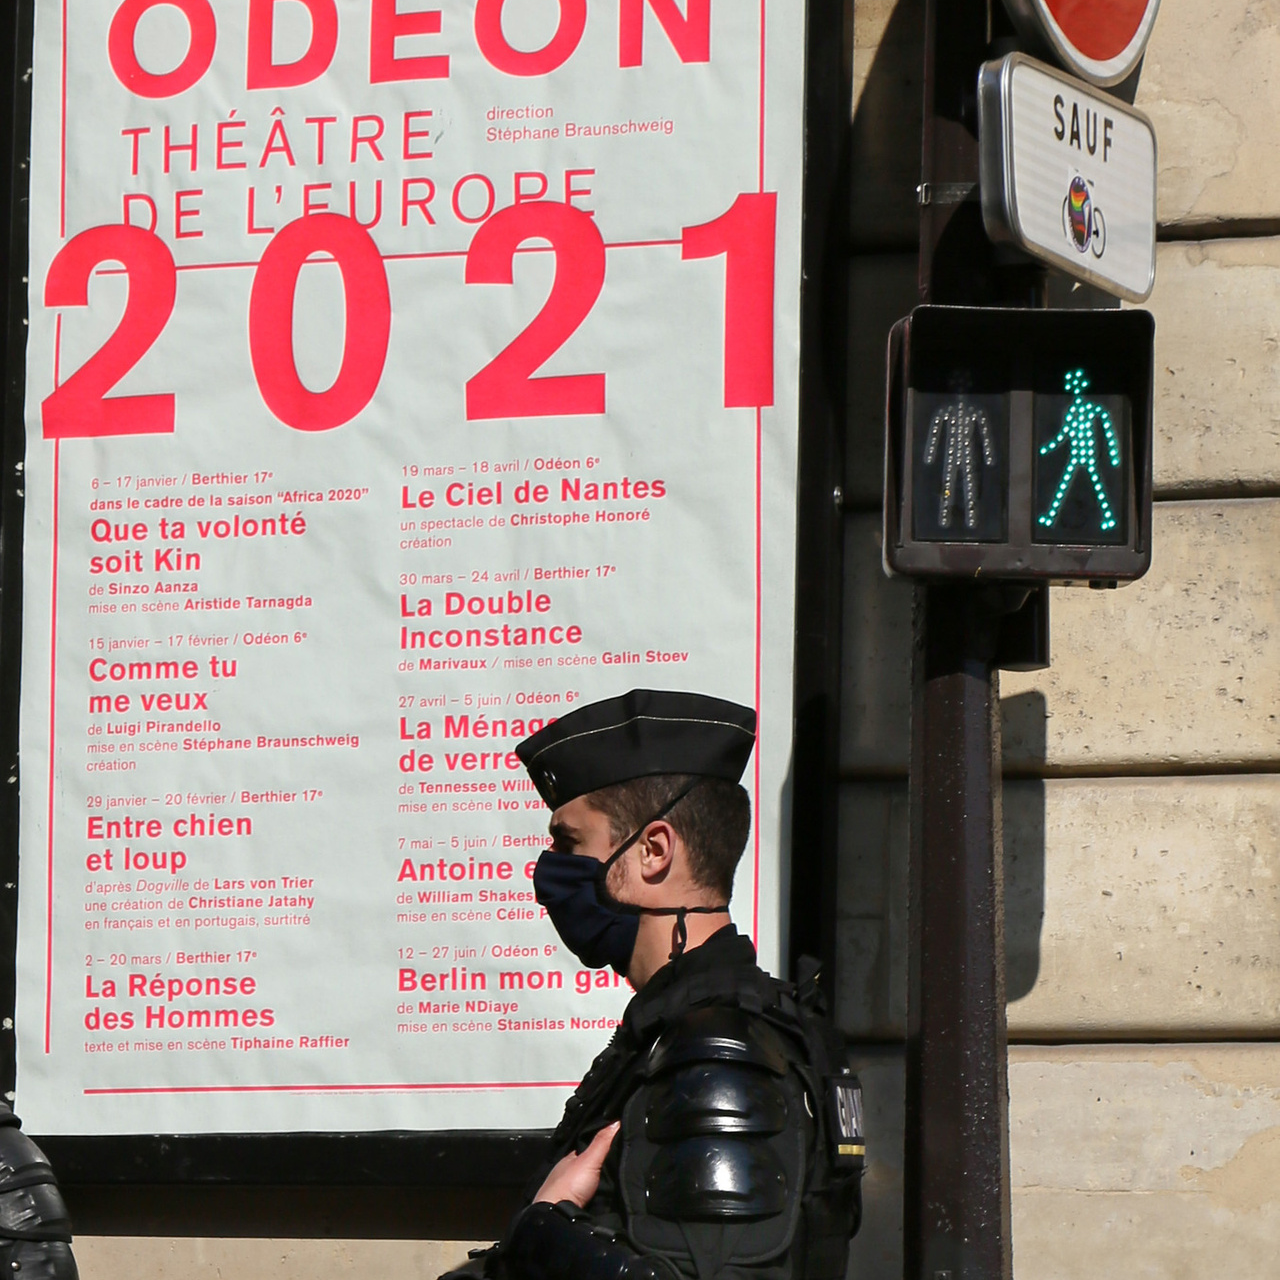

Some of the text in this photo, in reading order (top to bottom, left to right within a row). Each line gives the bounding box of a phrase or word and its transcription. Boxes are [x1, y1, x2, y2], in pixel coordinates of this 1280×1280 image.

[486, 107, 553, 121] direction
[487, 121, 673, 144] Stéphane Braunschweig
[1054, 94, 1113, 162] SAUF
[121, 106, 436, 175] THÉÂTRE
[122, 167, 598, 239] DE L'EUROPE
[40, 191, 778, 440] 2021
[90, 500, 122, 511] dans
[127, 498, 139, 509] le
[144, 497, 183, 509] cadre
[188, 496, 205, 507] de
[210, 495, 222, 507] la
[228, 495, 272, 506] saison
[402, 478, 666, 509] Le Ciel de Nantes
[91, 512, 305, 543] Que ta volonté
[400, 510, 650, 532] un spectacle de Christophe Honoré
[400, 537, 451, 549] création
[91, 549, 200, 574] soit Kin
[89, 582, 198, 596] de Sinzo Aanza
[89, 595, 312, 613] mise en scène Aristide Tarnagda
[401, 590, 550, 617] La Double
[401, 625, 581, 649] Inconstance
[89, 657, 236, 682] Comme tu
[398, 661, 414, 671] de
[419, 659, 486, 670] Marivaux
[504, 657, 533, 668] mise
[537, 658, 552, 667] en
[557, 655, 596, 666] scène
[602, 652, 640, 665] Galin
[646, 650, 688, 663] Stoev
[89, 694, 206, 713] me veux
[88, 720, 221, 737] de Luigi Pirandello
[400, 718, 431, 740] La
[87, 735, 359, 753] mise en scène Stéphane Braunschweig
[86, 761, 136, 772] création
[399, 750, 521, 773] de verre
[88, 814, 251, 839] Entre chien
[86, 848, 186, 874] et loup
[398, 858, 512, 882] Antoine
[85, 877, 313, 895] d'après Dogville de Lars von Trier
[85, 896, 314, 912] une création de Christiane Jatahy
[85, 915, 310, 931] en français et en portugais, surtitré
[86, 974, 256, 1002] La Réponse
[399, 968, 486, 991] Berlin
[500, 971, 562, 989] mon
[85, 1006, 274, 1030] des Hommes
[397, 1001, 518, 1015] de Marie NDiaye
[397, 1022, 427, 1033] mise
[432, 1023, 447, 1032] en
[452, 1021, 492, 1032] scène
[498, 1018, 564, 1031] Stanislas
[85, 1036, 349, 1053] texte et mise en scène Tiphaine Raffier
